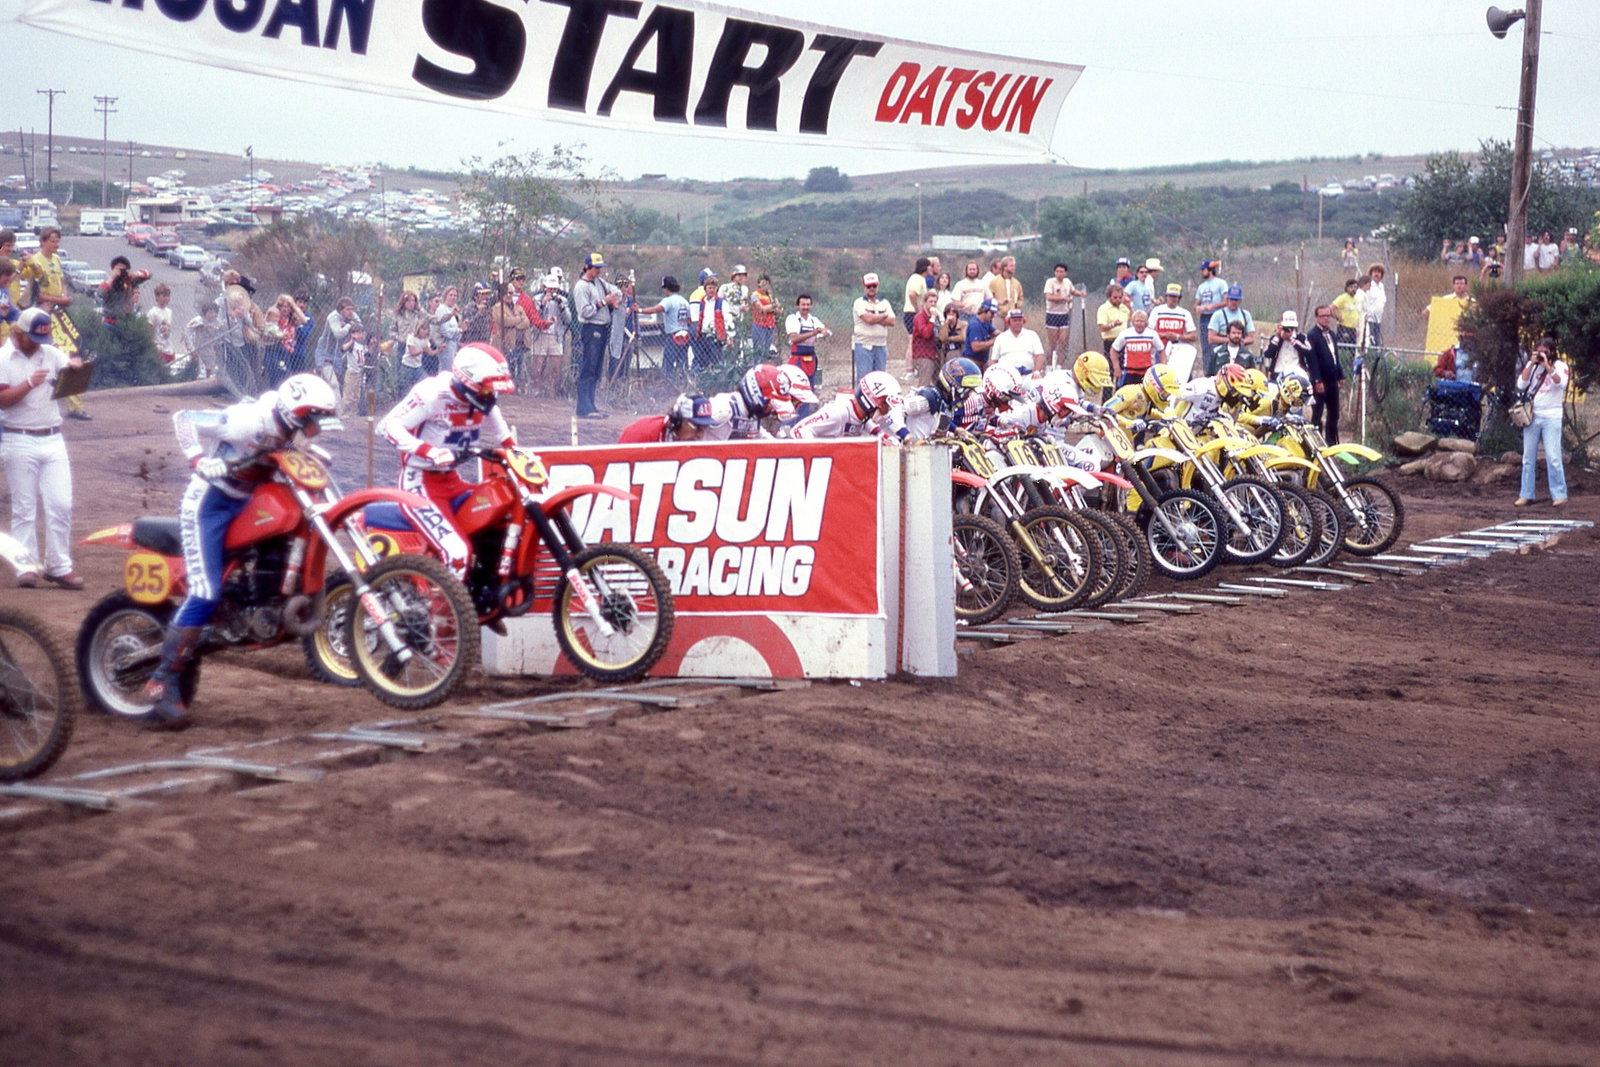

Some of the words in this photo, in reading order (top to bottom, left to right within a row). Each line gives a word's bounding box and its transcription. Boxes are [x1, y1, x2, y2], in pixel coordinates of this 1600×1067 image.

[412, 0, 884, 134] START
[876, 62, 1052, 134] DATSUN
[539, 457, 833, 545] DATSUN
[127, 562, 165, 595] 25
[655, 545, 815, 597] RACING
